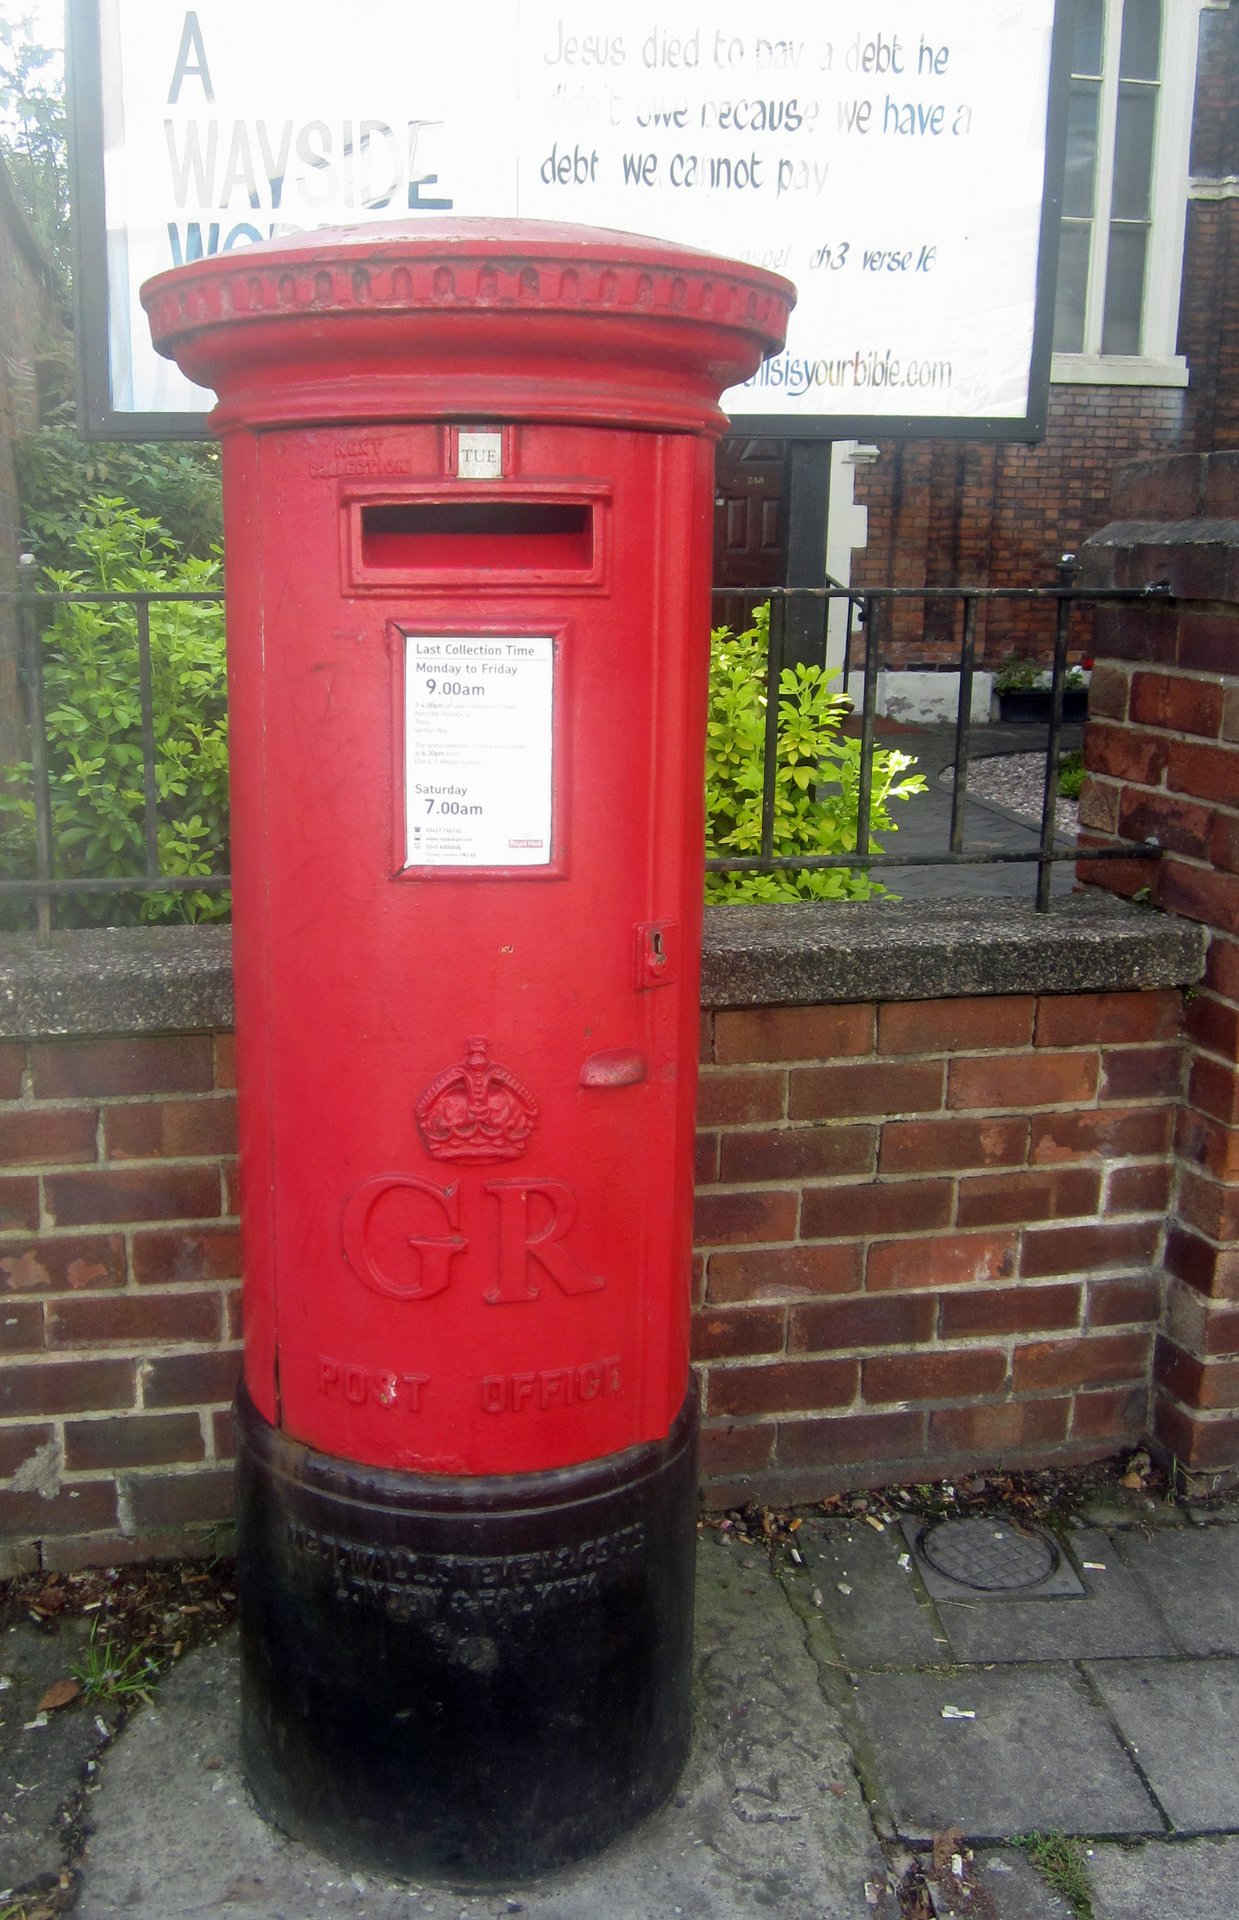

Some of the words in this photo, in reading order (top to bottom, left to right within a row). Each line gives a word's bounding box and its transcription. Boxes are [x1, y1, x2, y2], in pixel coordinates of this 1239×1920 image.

[543, 18, 626, 66] Jesus
[641, 26, 700, 69] died
[713, 30, 744, 70] to
[755, 37, 804, 76] pay
[818, 41, 833, 71] a
[845, 31, 905, 75] debt
[917, 32, 950, 76] he
[167, 11, 216, 104] A
[701, 91, 820, 132] because
[837, 98, 872, 135] we
[883, 94, 945, 136] have
[951, 103, 973, 136] a
[164, 119, 453, 210] WAYSIDE
[540, 141, 600, 186] debt
[622, 152, 659, 187] we
[669, 145, 765, 191] cannot
[776, 156, 831, 200] pay
[862, 248, 913, 272] verse
[335, 439, 383, 458] NEXT
[462, 449, 497, 463] TUE
[309, 458, 410, 477] COLLECTION
[416, 644, 441, 655] Last
[445, 644, 502, 655] Collection
[506, 645, 535, 656] Time
[416, 663, 461, 676] Monday
[466, 664, 477, 674] to
[482, 664, 518, 676] Friday
[426, 678, 485, 696] 9.00am
[415, 784, 468, 797] Saturday
[424, 798, 483, 815] 7.00am
[318, 1354, 430, 1413] POST
